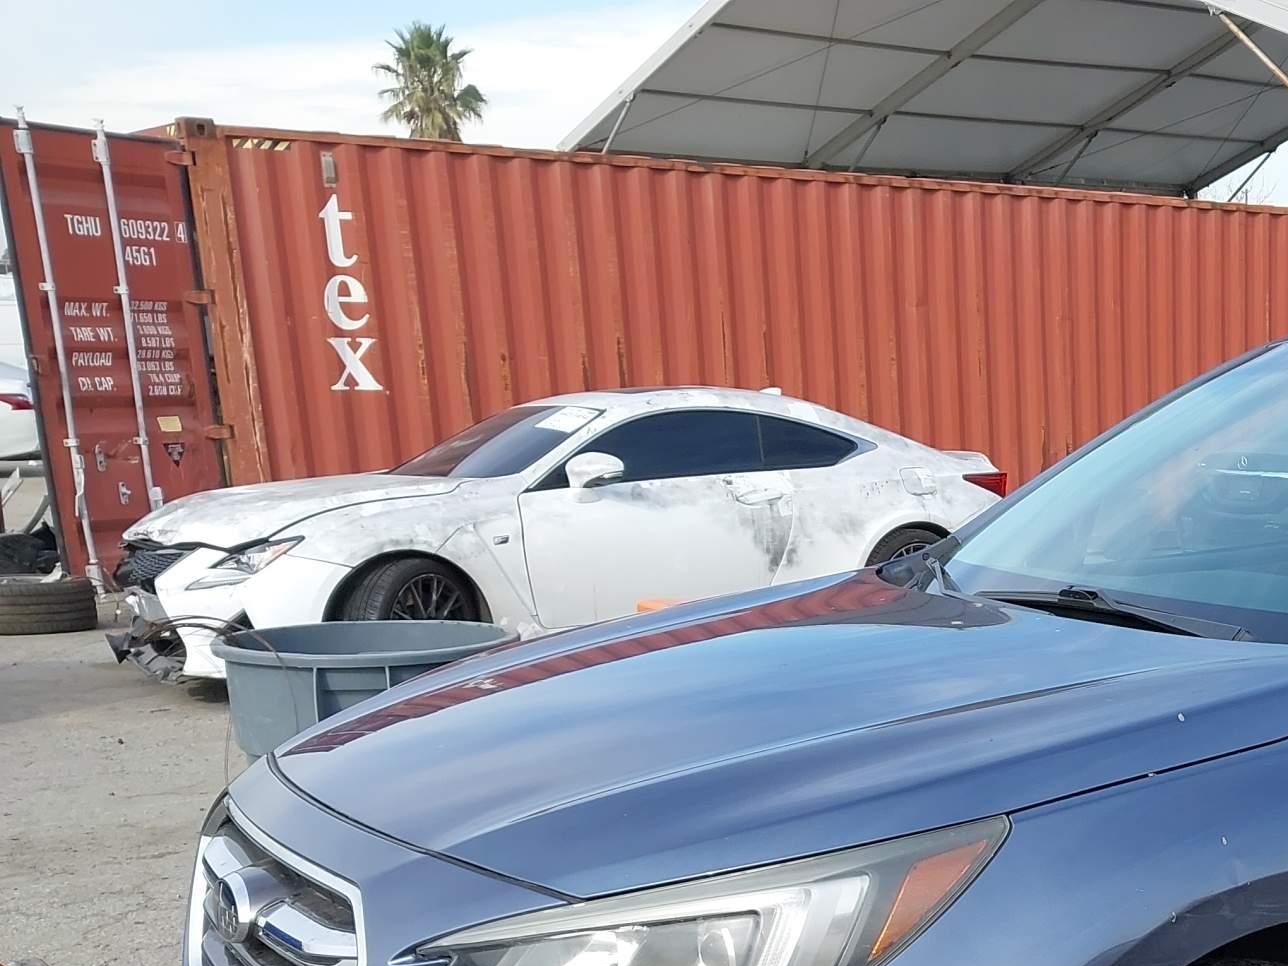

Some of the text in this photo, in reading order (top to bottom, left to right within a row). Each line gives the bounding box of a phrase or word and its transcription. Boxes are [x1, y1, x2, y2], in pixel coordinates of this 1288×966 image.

[64, 214, 101, 236] TGHU
[120, 218, 170, 241] 609322
[125, 245, 157, 267] 45G1
[318, 193, 384, 391] tex
[64, 302, 90, 317] MAX.
[91, 302, 111, 317] WT.
[69, 327, 96, 342] TARE
[96, 327, 118, 342] WT.
[72, 352, 112, 367] PAYLOAD
[94, 377, 117, 391] CAP.
